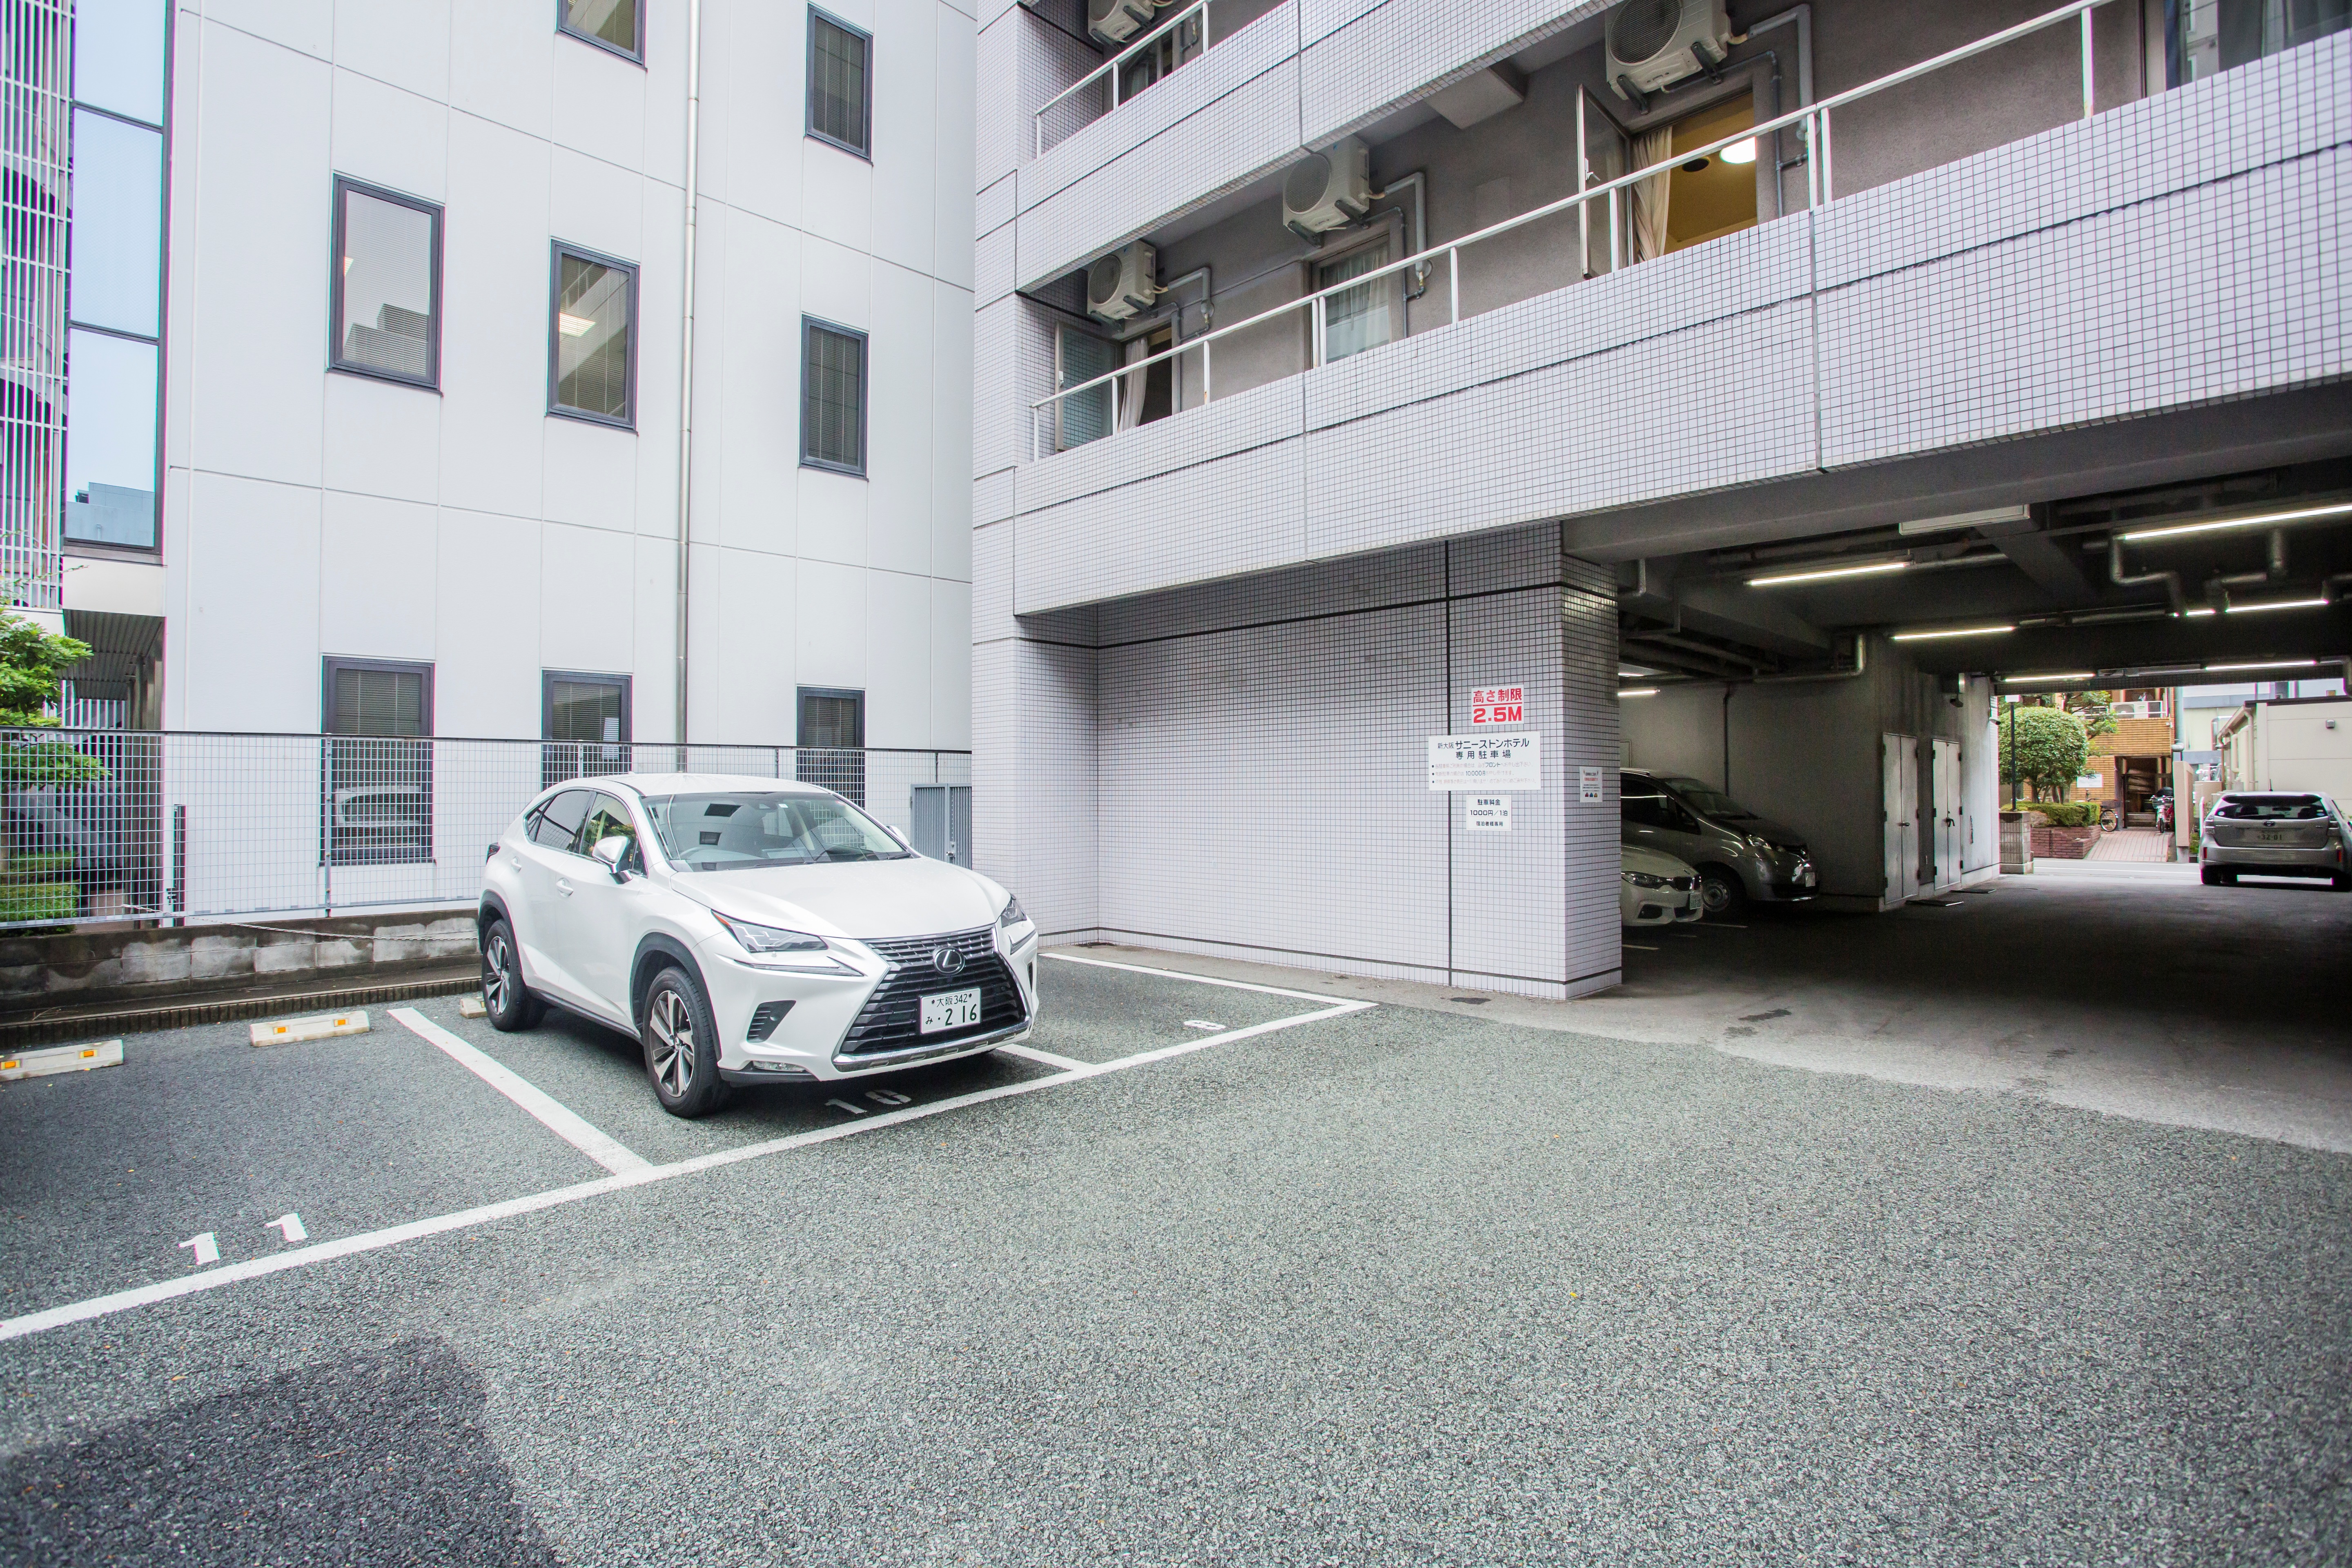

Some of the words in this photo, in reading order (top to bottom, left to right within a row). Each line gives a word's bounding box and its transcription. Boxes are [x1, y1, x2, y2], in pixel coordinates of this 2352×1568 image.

[1473, 688, 1522, 703] 高さ制限
[1473, 706, 1522, 723] 2.5M
[824, 1089, 912, 1114] 10
